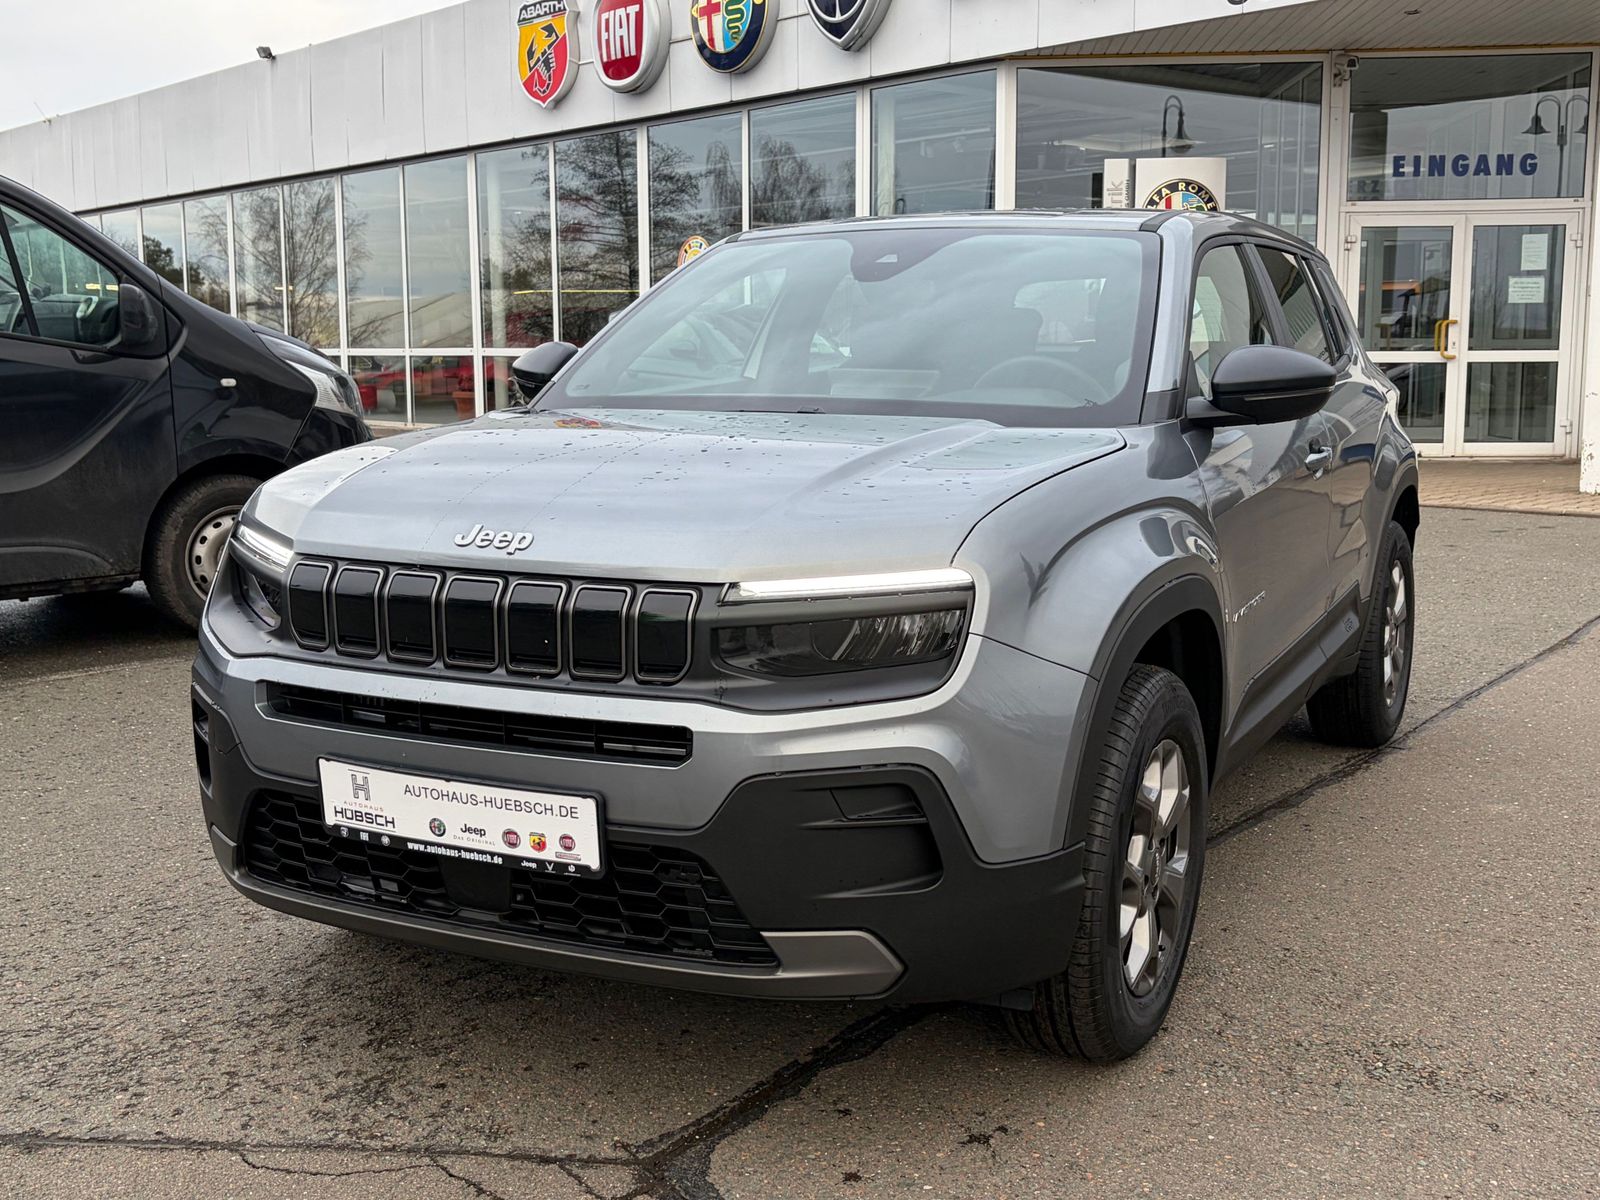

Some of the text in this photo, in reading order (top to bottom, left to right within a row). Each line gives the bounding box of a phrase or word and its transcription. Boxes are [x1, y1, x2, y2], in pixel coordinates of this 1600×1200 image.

[519, 1, 564, 20] ABARTH
[601, 4, 640, 62] FIAT
[1392, 153, 1538, 177] EINGANG
[1178, 182, 1216, 210] ROME
[454, 523, 534, 555] Jeep
[344, 801, 384, 812] AUTOHAUS
[403, 784, 579, 819] AUTOHAUS-HUEBSCH.DE
[334, 805, 395, 829] HÜBSCH
[461, 823, 486, 838] Jeep
[407, 841, 503, 865] www.autohaus-huebsch.de
[521, 860, 537, 869] Jeep
